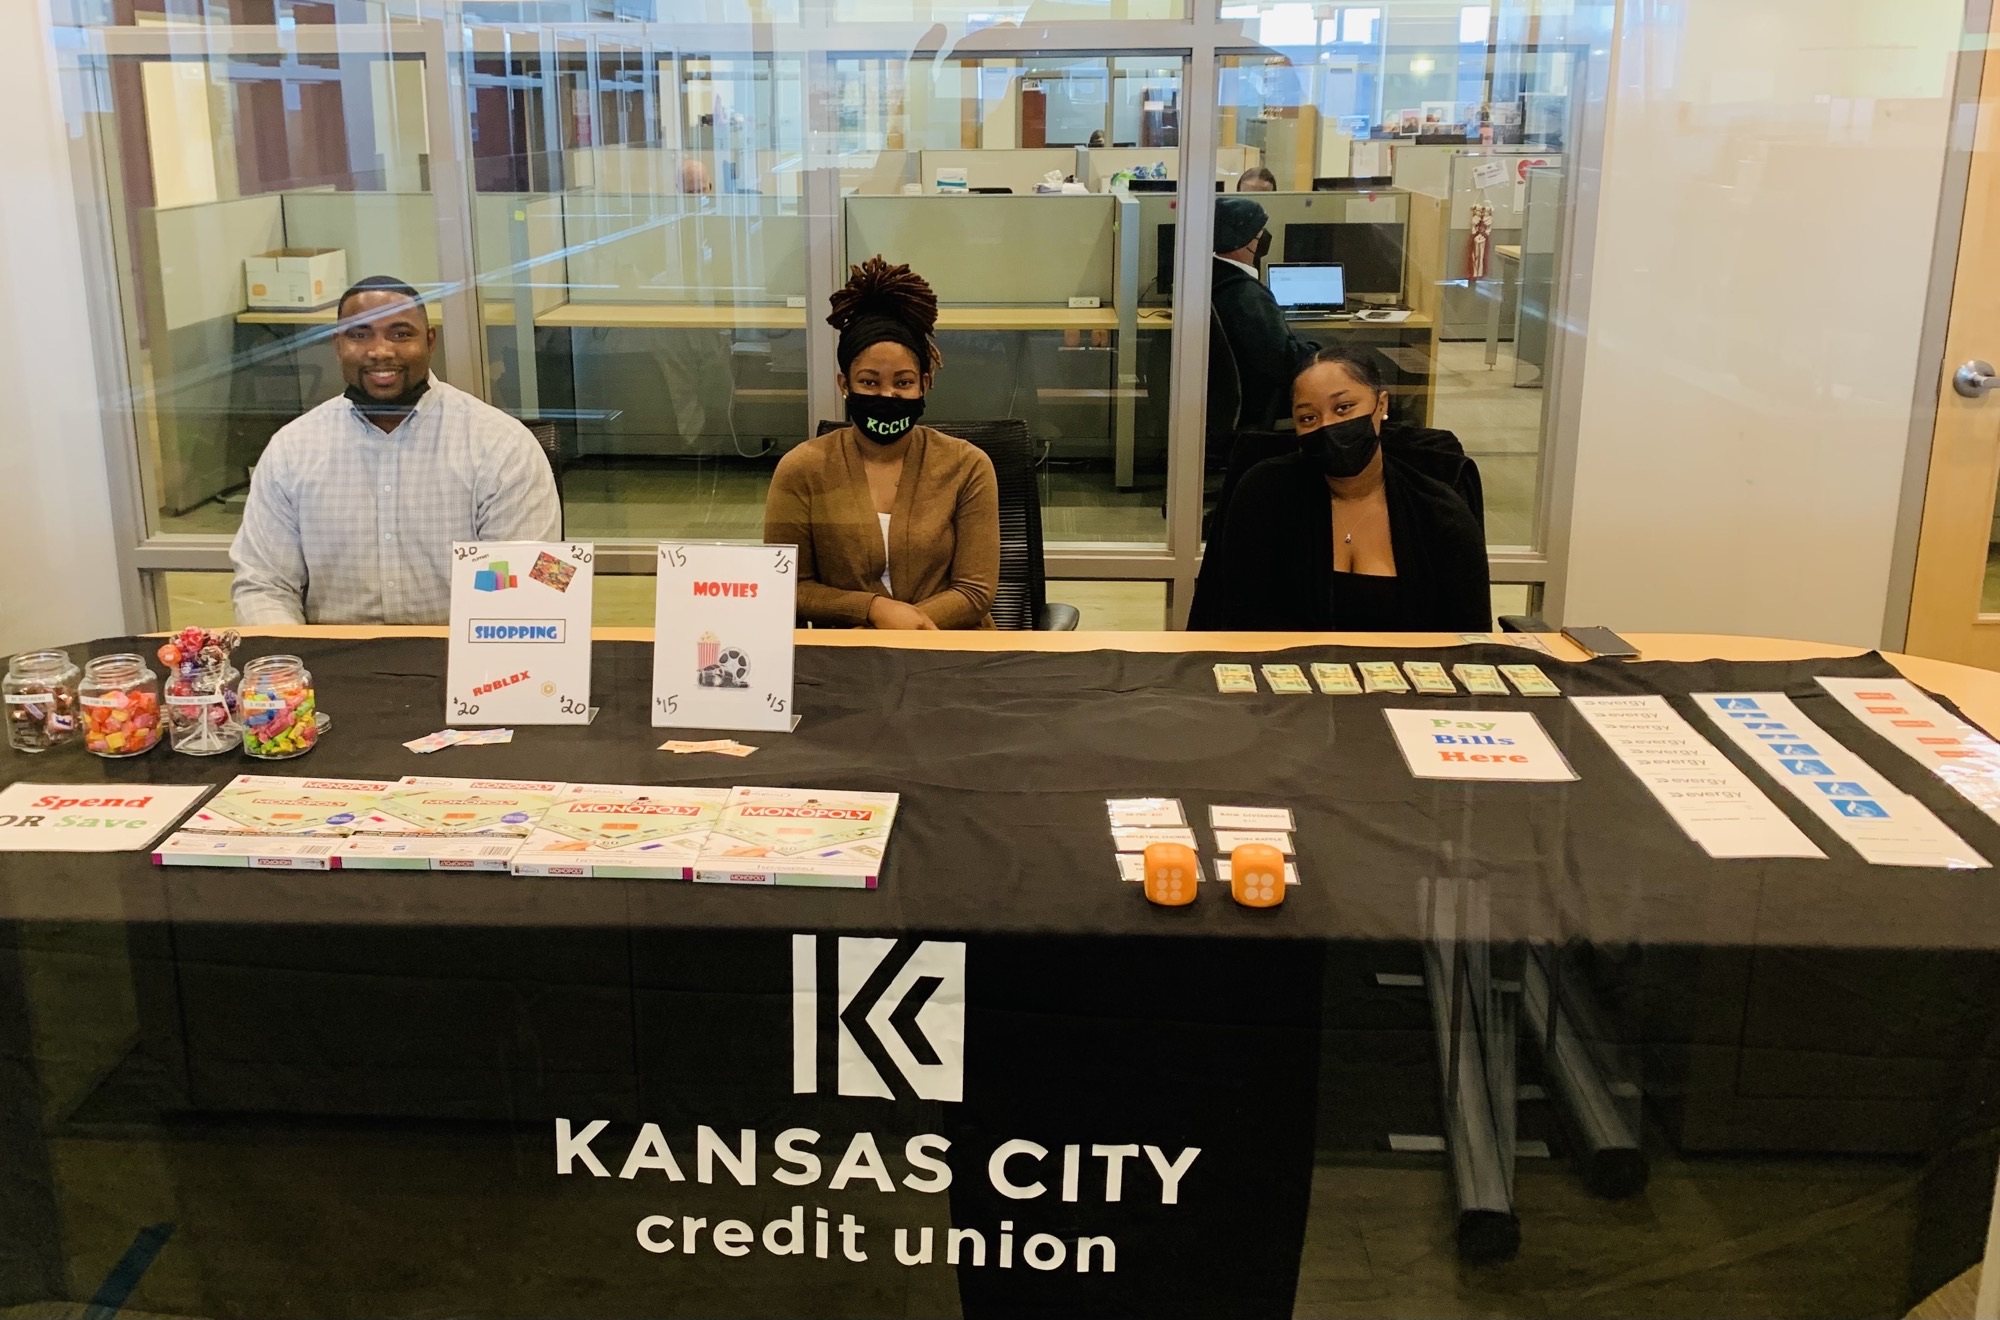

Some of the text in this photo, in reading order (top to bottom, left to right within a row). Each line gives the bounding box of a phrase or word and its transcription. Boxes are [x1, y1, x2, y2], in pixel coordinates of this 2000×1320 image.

[867, 416, 910, 435] KCCU
[454, 546, 478, 560] $20
[571, 545, 592, 563] $20
[661, 546, 687, 568] $15
[774, 550, 793, 574] $15
[694, 581, 758, 598] MOVIES
[475, 625, 557, 639] SHOPPING
[472, 670, 531, 697] ROBLOX
[453, 697, 480, 716] $20
[560, 695, 586, 715] $20
[657, 694, 679, 715] $15
[767, 692, 786, 713] $15
[1430, 719, 1496, 731] Pay
[1432, 735, 1515, 745] Bills
[1438, 751, 1529, 763] Here
[304, 781, 387, 791] MONOPOLY
[472, 782, 553, 791] MONOPOLY
[1671, 777, 1727, 785] evergy
[32, 795, 154, 810] Spend
[254, 799, 346, 807] MONOPOLY
[572, 804, 699, 816] MONOPOLY
[744, 807, 869, 821] MONOPOLY
[54, 815, 148, 829] Save
[555, 1117, 1202, 1204] KANSAS CITY
[636, 1205, 1117, 1273] credit union
